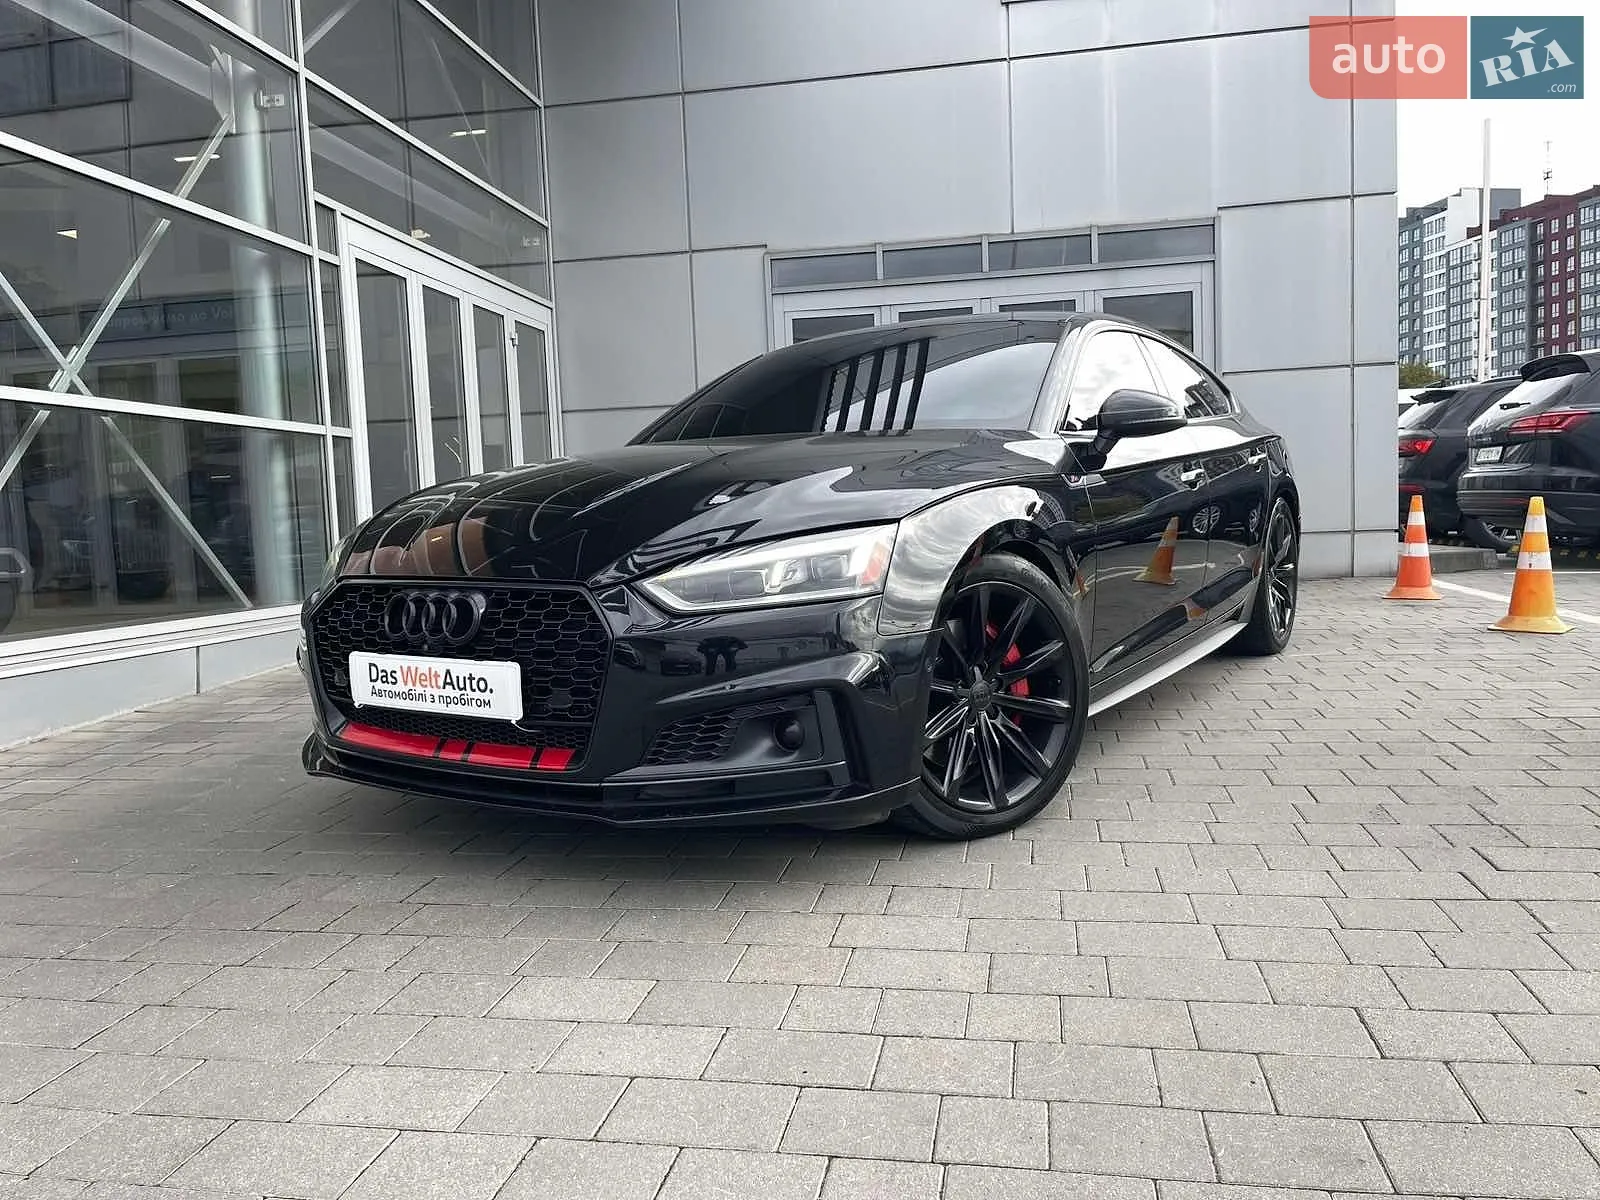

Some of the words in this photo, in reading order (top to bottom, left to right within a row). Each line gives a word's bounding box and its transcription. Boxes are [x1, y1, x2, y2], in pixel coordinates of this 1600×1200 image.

[371, 685, 427, 703] Автомобілі
[430, 694, 435, 704] з
[438, 694, 491, 709] пробігом
